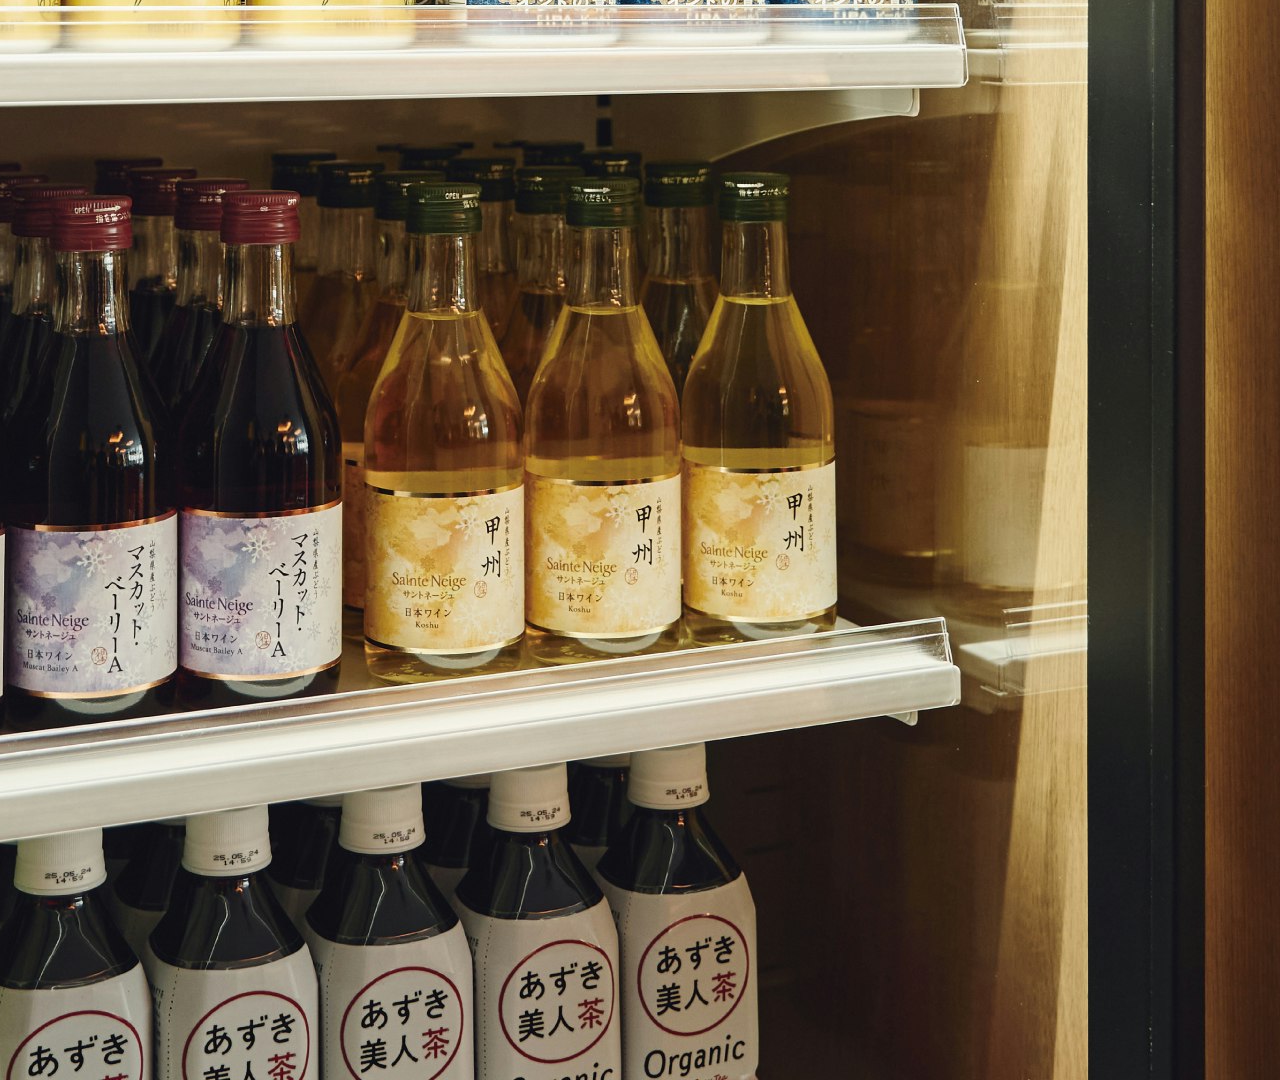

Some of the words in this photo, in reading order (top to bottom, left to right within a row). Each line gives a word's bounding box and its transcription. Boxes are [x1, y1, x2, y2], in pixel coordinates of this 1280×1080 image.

[783, 493, 804, 552] 甲州
[632, 505, 653, 565] 甲州
[481, 515, 501, 578] 甲州
[701, 541, 732, 557] Sainte
[734, 546, 768, 560] Neige
[547, 556, 580, 573] Sainte
[582, 561, 617, 577] Neige
[710, 560, 755, 570] サントネージュ
[392, 571, 429, 587] Sainte
[431, 575, 466, 591] Neige
[557, 575, 605, 585] サントネージュ
[712, 576, 754, 587] 日本ワイン
[403, 591, 454, 600] サントネージュ
[558, 592, 603, 603] 日本ワイン
[721, 589, 742, 598] Koshu
[186, 592, 216, 610] Sainte
[218, 599, 253, 615] Neige
[568, 604, 591, 613] Koshu
[17, 609, 49, 625] Sainte
[194, 612, 240, 624] サントネージュ
[406, 608, 452, 618] 日本ワイン
[415, 621, 439, 629] Koshu
[26, 630, 76, 640] サントネージュ
[195, 631, 238, 644] 日本ワイン
[28, 649, 72, 660] 日本ワイン
[190, 643, 212, 654] Muscat
[47, 663, 71, 673] Bailey
[656, 936, 735, 974] あずき
[519, 961, 603, 1000] あずき
[655, 971, 737, 1016] 美人茶
[361, 989, 449, 1029] あずき
[519, 997, 604, 1042] 美人茶
[204, 1014, 295, 1055] あずき
[28, 1034, 129, 1077] あずき
[360, 1026, 450, 1073] 美人茶
[644, 1034, 745, 1078] Organic
